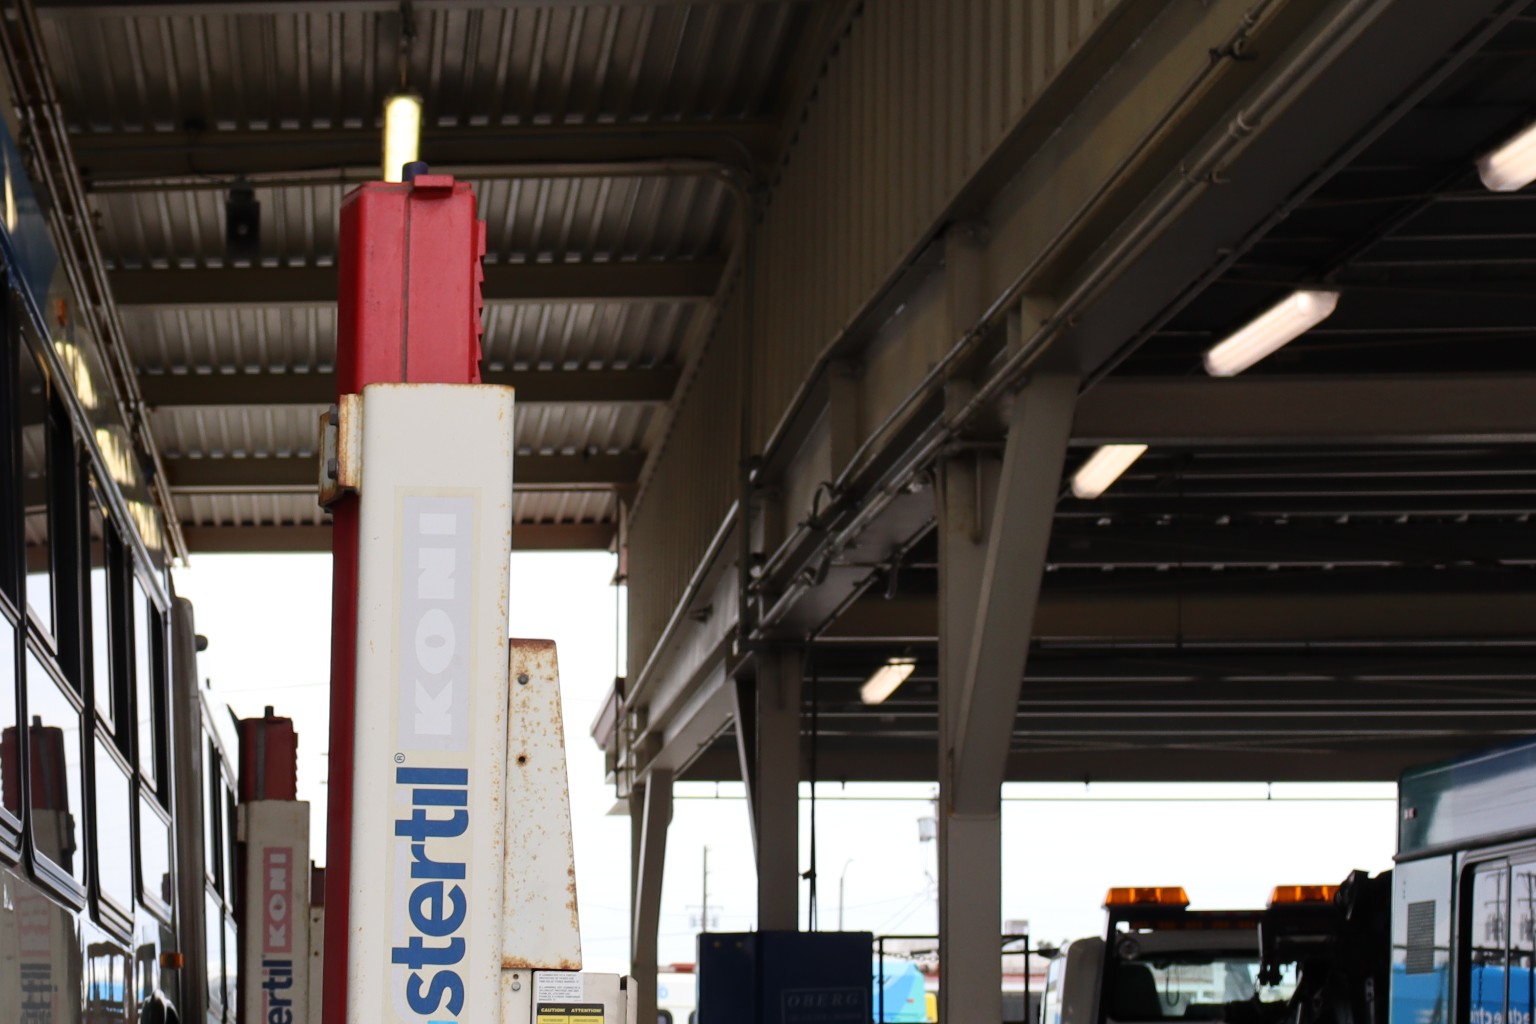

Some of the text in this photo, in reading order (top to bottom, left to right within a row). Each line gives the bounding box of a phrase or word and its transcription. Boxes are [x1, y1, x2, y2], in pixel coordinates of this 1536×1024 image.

[414, 513, 457, 735] KONI
[267, 853, 287, 947] KONI
[391, 767, 468, 1016] stertil
